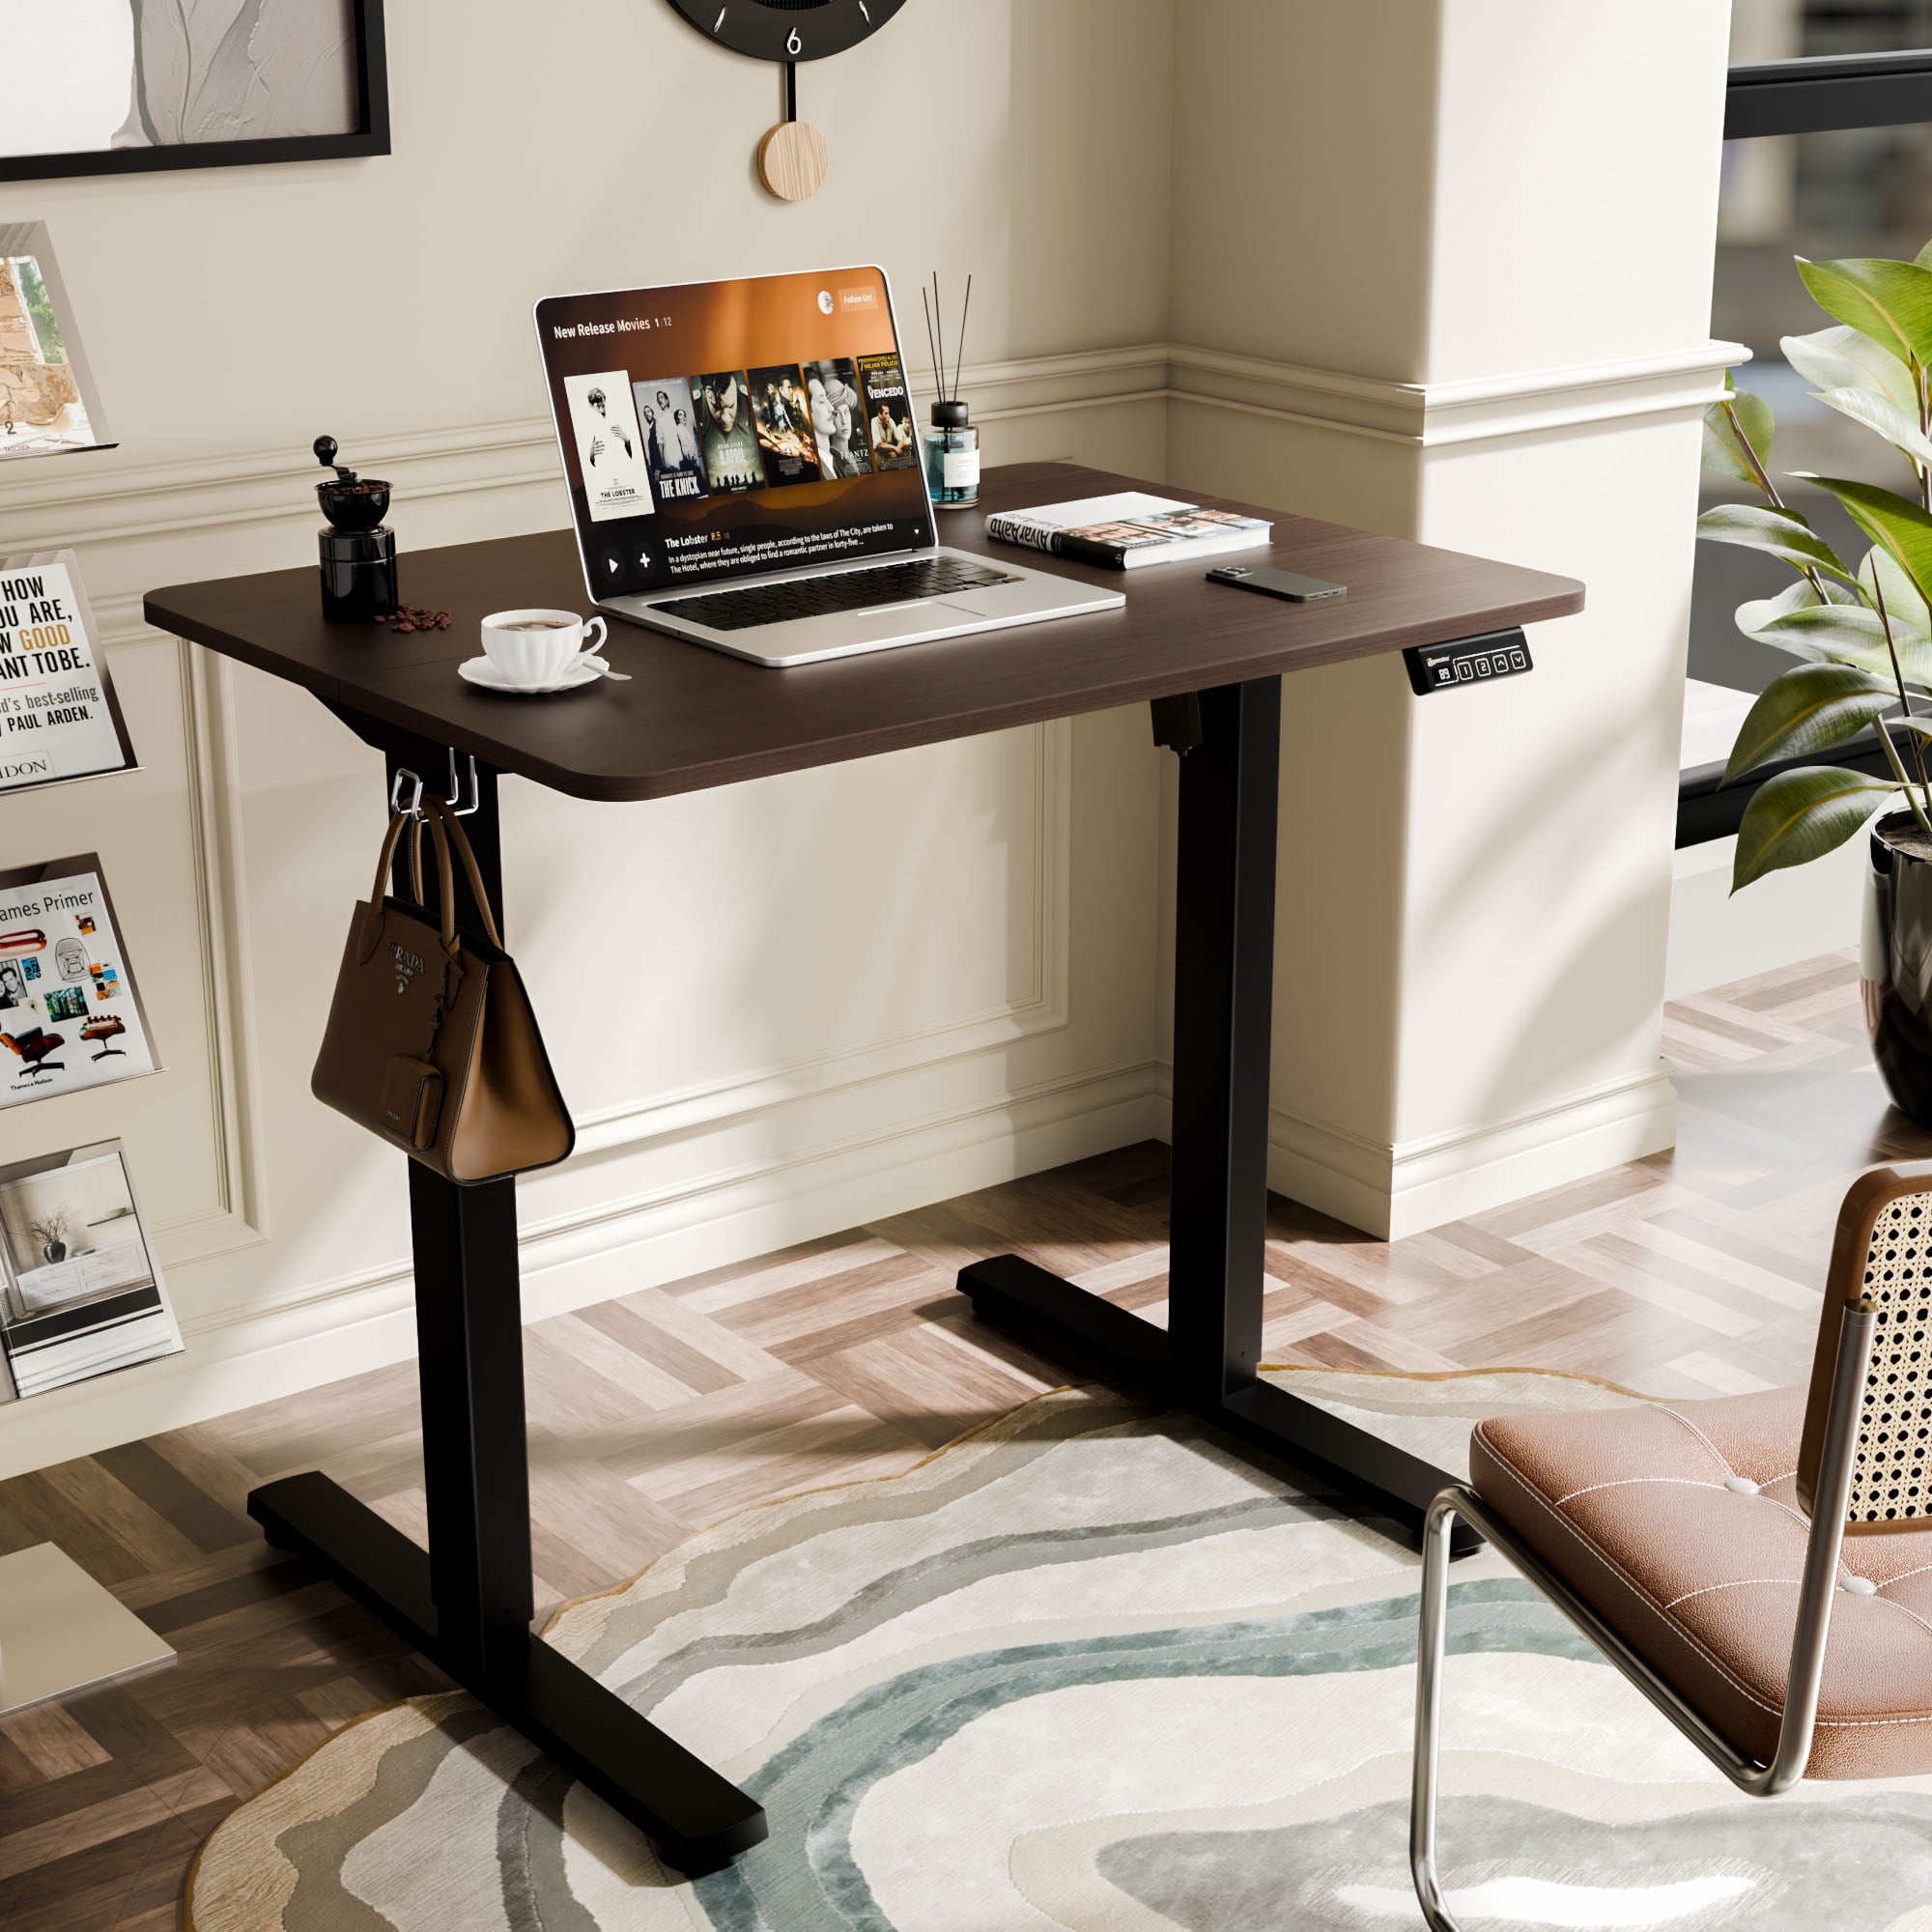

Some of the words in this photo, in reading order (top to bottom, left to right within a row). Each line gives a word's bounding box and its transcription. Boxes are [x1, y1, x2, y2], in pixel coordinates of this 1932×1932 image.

[786, 26, 802, 54] 6
[843, 295, 862, 304] Follow
[554, 327, 576, 339] New
[577, 322, 615, 337] Release
[616, 317, 651, 332] Movies
[4, 420, 17, 435] 2
[840, 448, 868, 460] FRANTZ
[601, 491, 611, 499] THE
[611, 488, 636, 497] LOBSTER
[659, 479, 676, 499] THE
[675, 475, 700, 497] KNICK
[665, 537, 680, 549] The
[680, 534, 708, 547] Lobster
[990, 518, 1021, 543] Aalto
[1020, 525, 1050, 551] Alvar
[668, 555, 675, 564] In
[680, 551, 707, 564] dystopian
[720, 547, 740, 555] future,
[740, 543, 756, 554] single
[756, 540, 778, 552] people,
[778, 537, 805, 548] according
[810, 533, 820, 542] the
[820, 531, 833, 540] laws
[833, 529, 839, 538] of
[839, 528, 850, 537] The
[850, 527, 863, 537] City,
[871, 524, 887, 533] taken
[669, 565, 682, 575] The
[682, 562, 700, 572] Hotel,
[699, 560, 717, 570] where
[717, 558, 730, 568] they
[739, 553, 761, 564] obliged
[767, 550, 780, 559] find
[783, 546, 808, 557] romantic
[808, 543, 828, 554] partner
[828, 541, 835, 550] in
[834, 538, 859, 550] forty-five
[1, 576, 44, 602] HOW
[29, 599, 72, 624] ARE,
[19, 624, 71, 651] GOOD
[1480, 662, 1488, 671] 2
[0, 697, 21, 714] d's
[25, 686, 99, 710] best-selling
[7, 714, 43, 732] PAUL
[46, 705, 94, 726] ARDEN.
[0, 759, 47, 779] DON
[43, 892, 94, 913] Primer
[388, 942, 425, 974] PRADA
